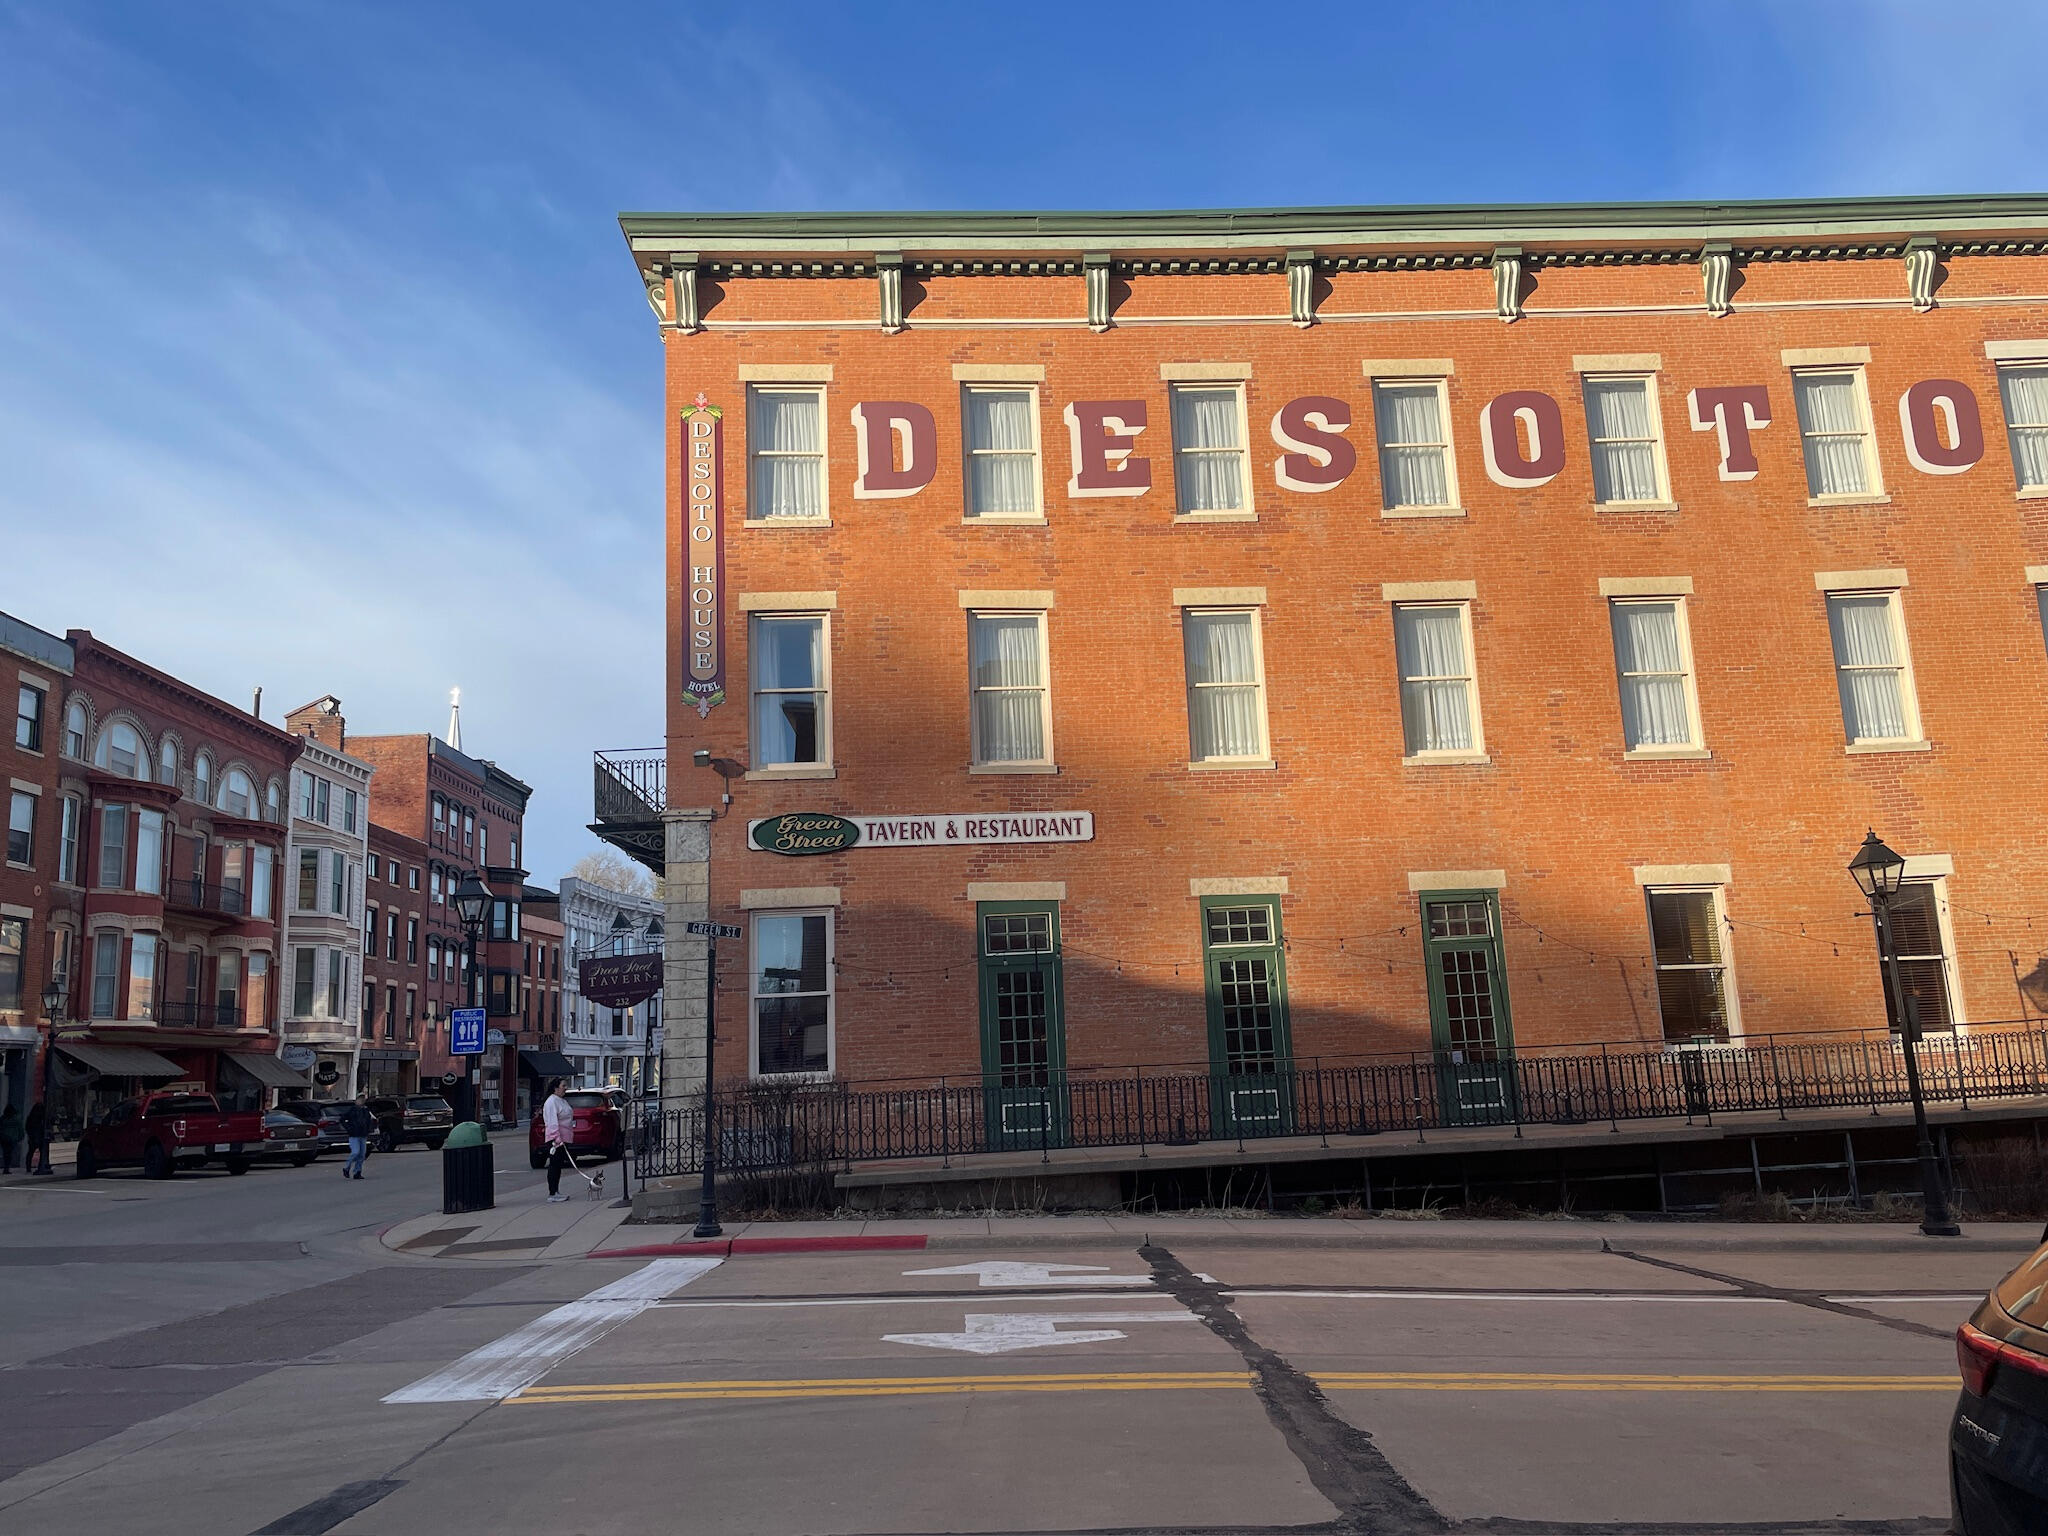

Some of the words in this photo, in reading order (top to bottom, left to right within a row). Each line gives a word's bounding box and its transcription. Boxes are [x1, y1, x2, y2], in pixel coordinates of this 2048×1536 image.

[692, 421, 713, 543] DESOTO
[692, 566, 713, 671] HOUSE
[687, 680, 721, 693] HOTEL
[776, 814, 844, 832] Green
[865, 820, 936, 841] TAVERN
[946, 820, 959, 839] &
[965, 817, 1084, 838] RESTAURANT
[775, 829, 846, 850] Street
[692, 922, 722, 936] GREEN
[615, 997, 630, 1006] 232
[1960, 1414, 2001, 1446] SPORTAGE
